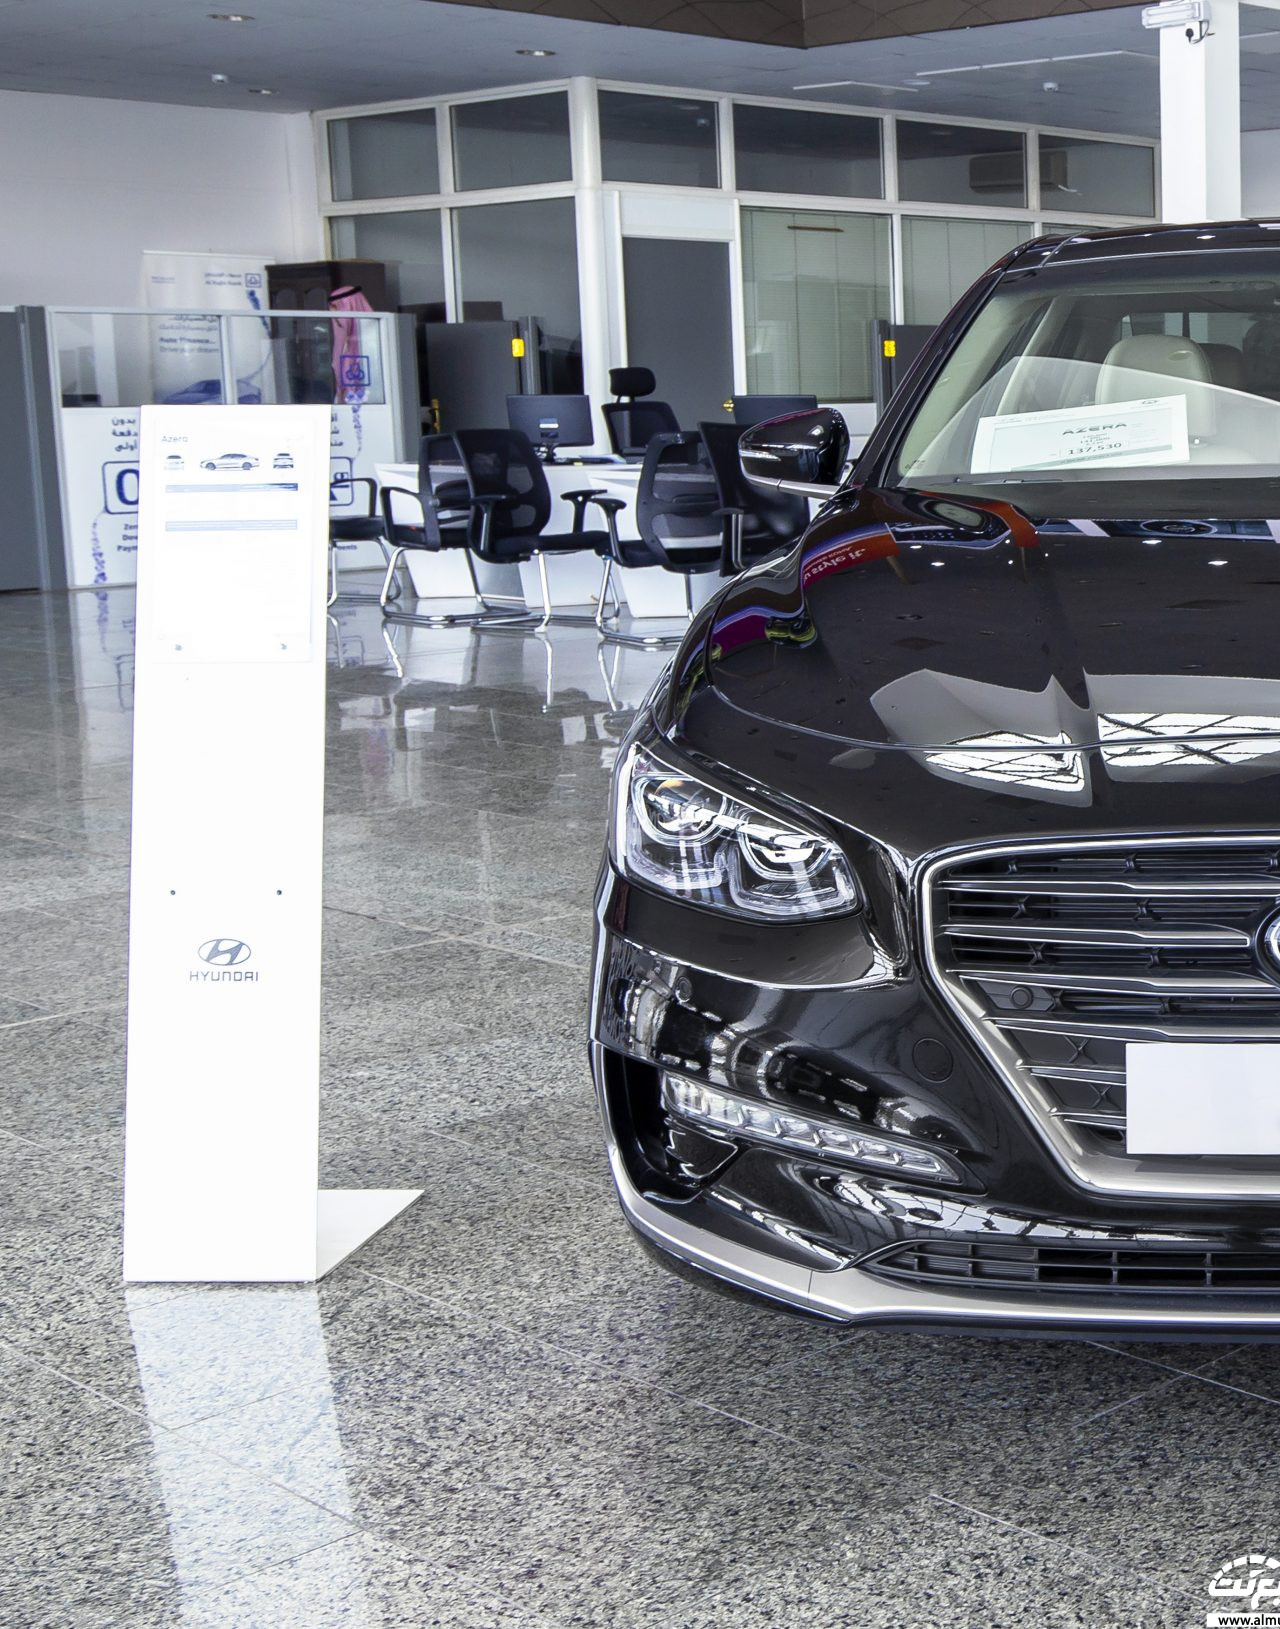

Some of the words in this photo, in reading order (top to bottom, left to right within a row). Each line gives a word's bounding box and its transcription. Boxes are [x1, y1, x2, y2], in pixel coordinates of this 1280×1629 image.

[1062, 423, 1127, 435] AZERA
[1068, 442, 1122, 455] 137,530
[189, 971, 259, 982] HYUNDAI
